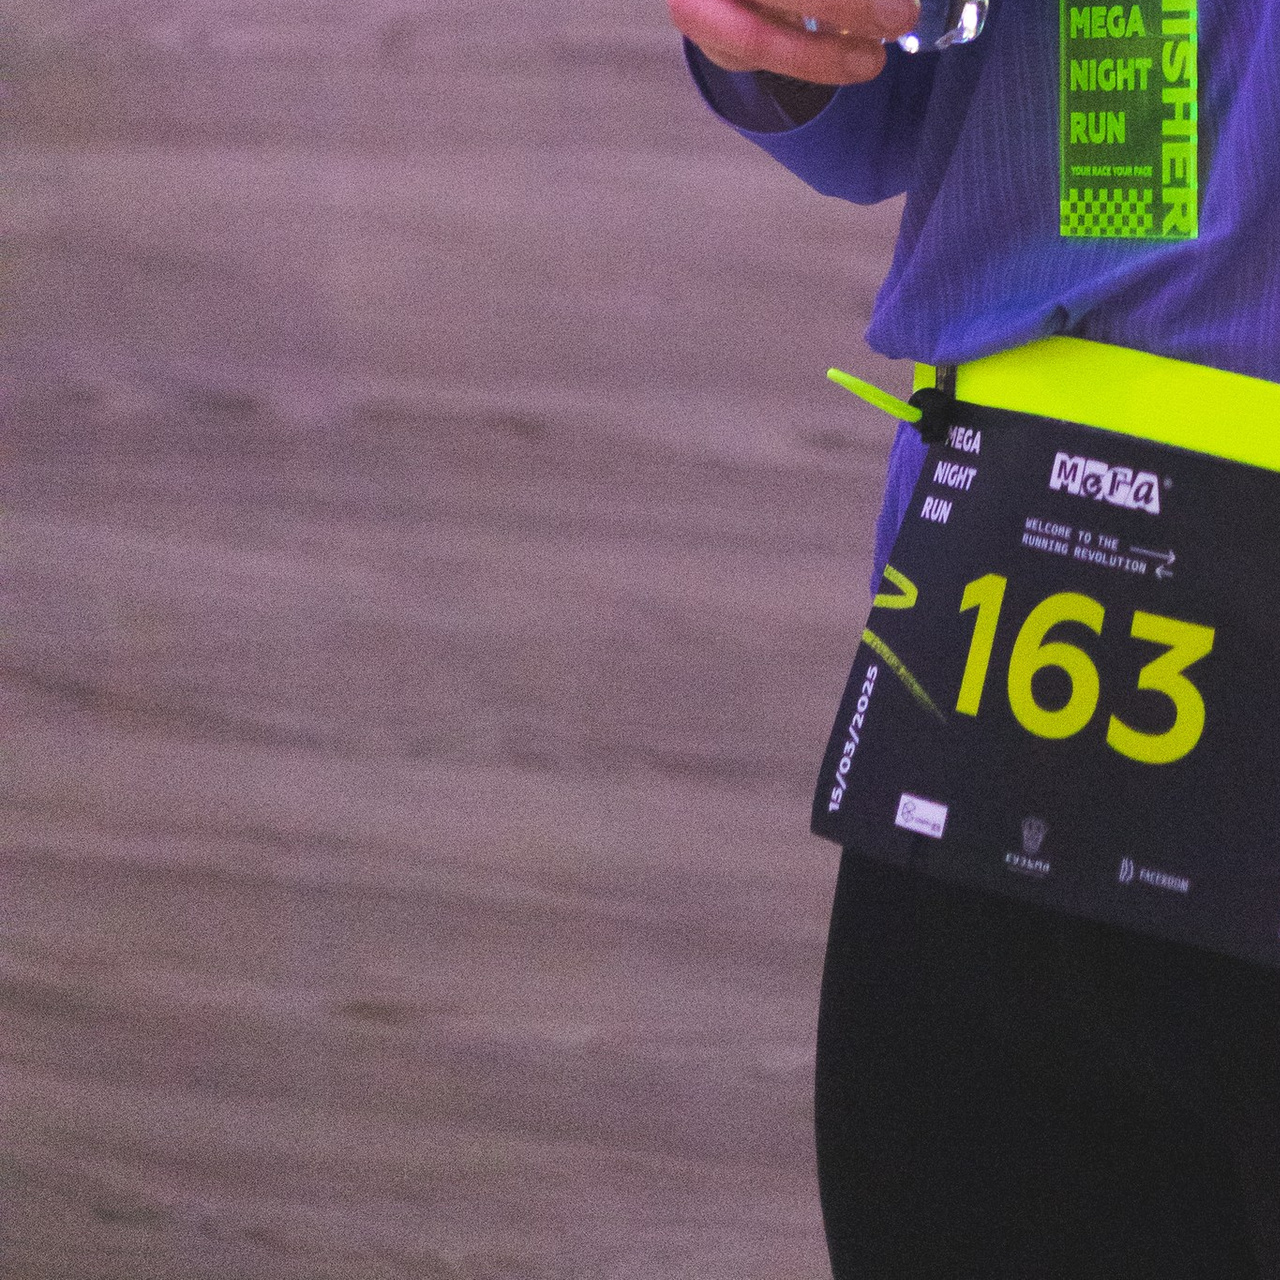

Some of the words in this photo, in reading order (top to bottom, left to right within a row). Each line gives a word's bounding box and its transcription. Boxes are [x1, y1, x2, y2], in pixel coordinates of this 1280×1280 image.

[1070, 4, 1146, 39] MEGA
[1070, 57, 1152, 91] NIGHT
[1070, 112, 1126, 144] RUN
[945, 425, 981, 455] MEGA
[933, 461, 977, 491] NIGHT
[920, 496, 952, 524] RUN
[1025, 516, 1072, 539] WELCOME
[1078, 530, 1092, 545] TO
[1098, 535, 1119, 550] THE
[1022, 532, 1069, 556] RUNNING
[1073, 546, 1147, 575] REVOLUTION
[955, 573, 1215, 764] 163
[829, 664, 878, 812] 15/03/2025
